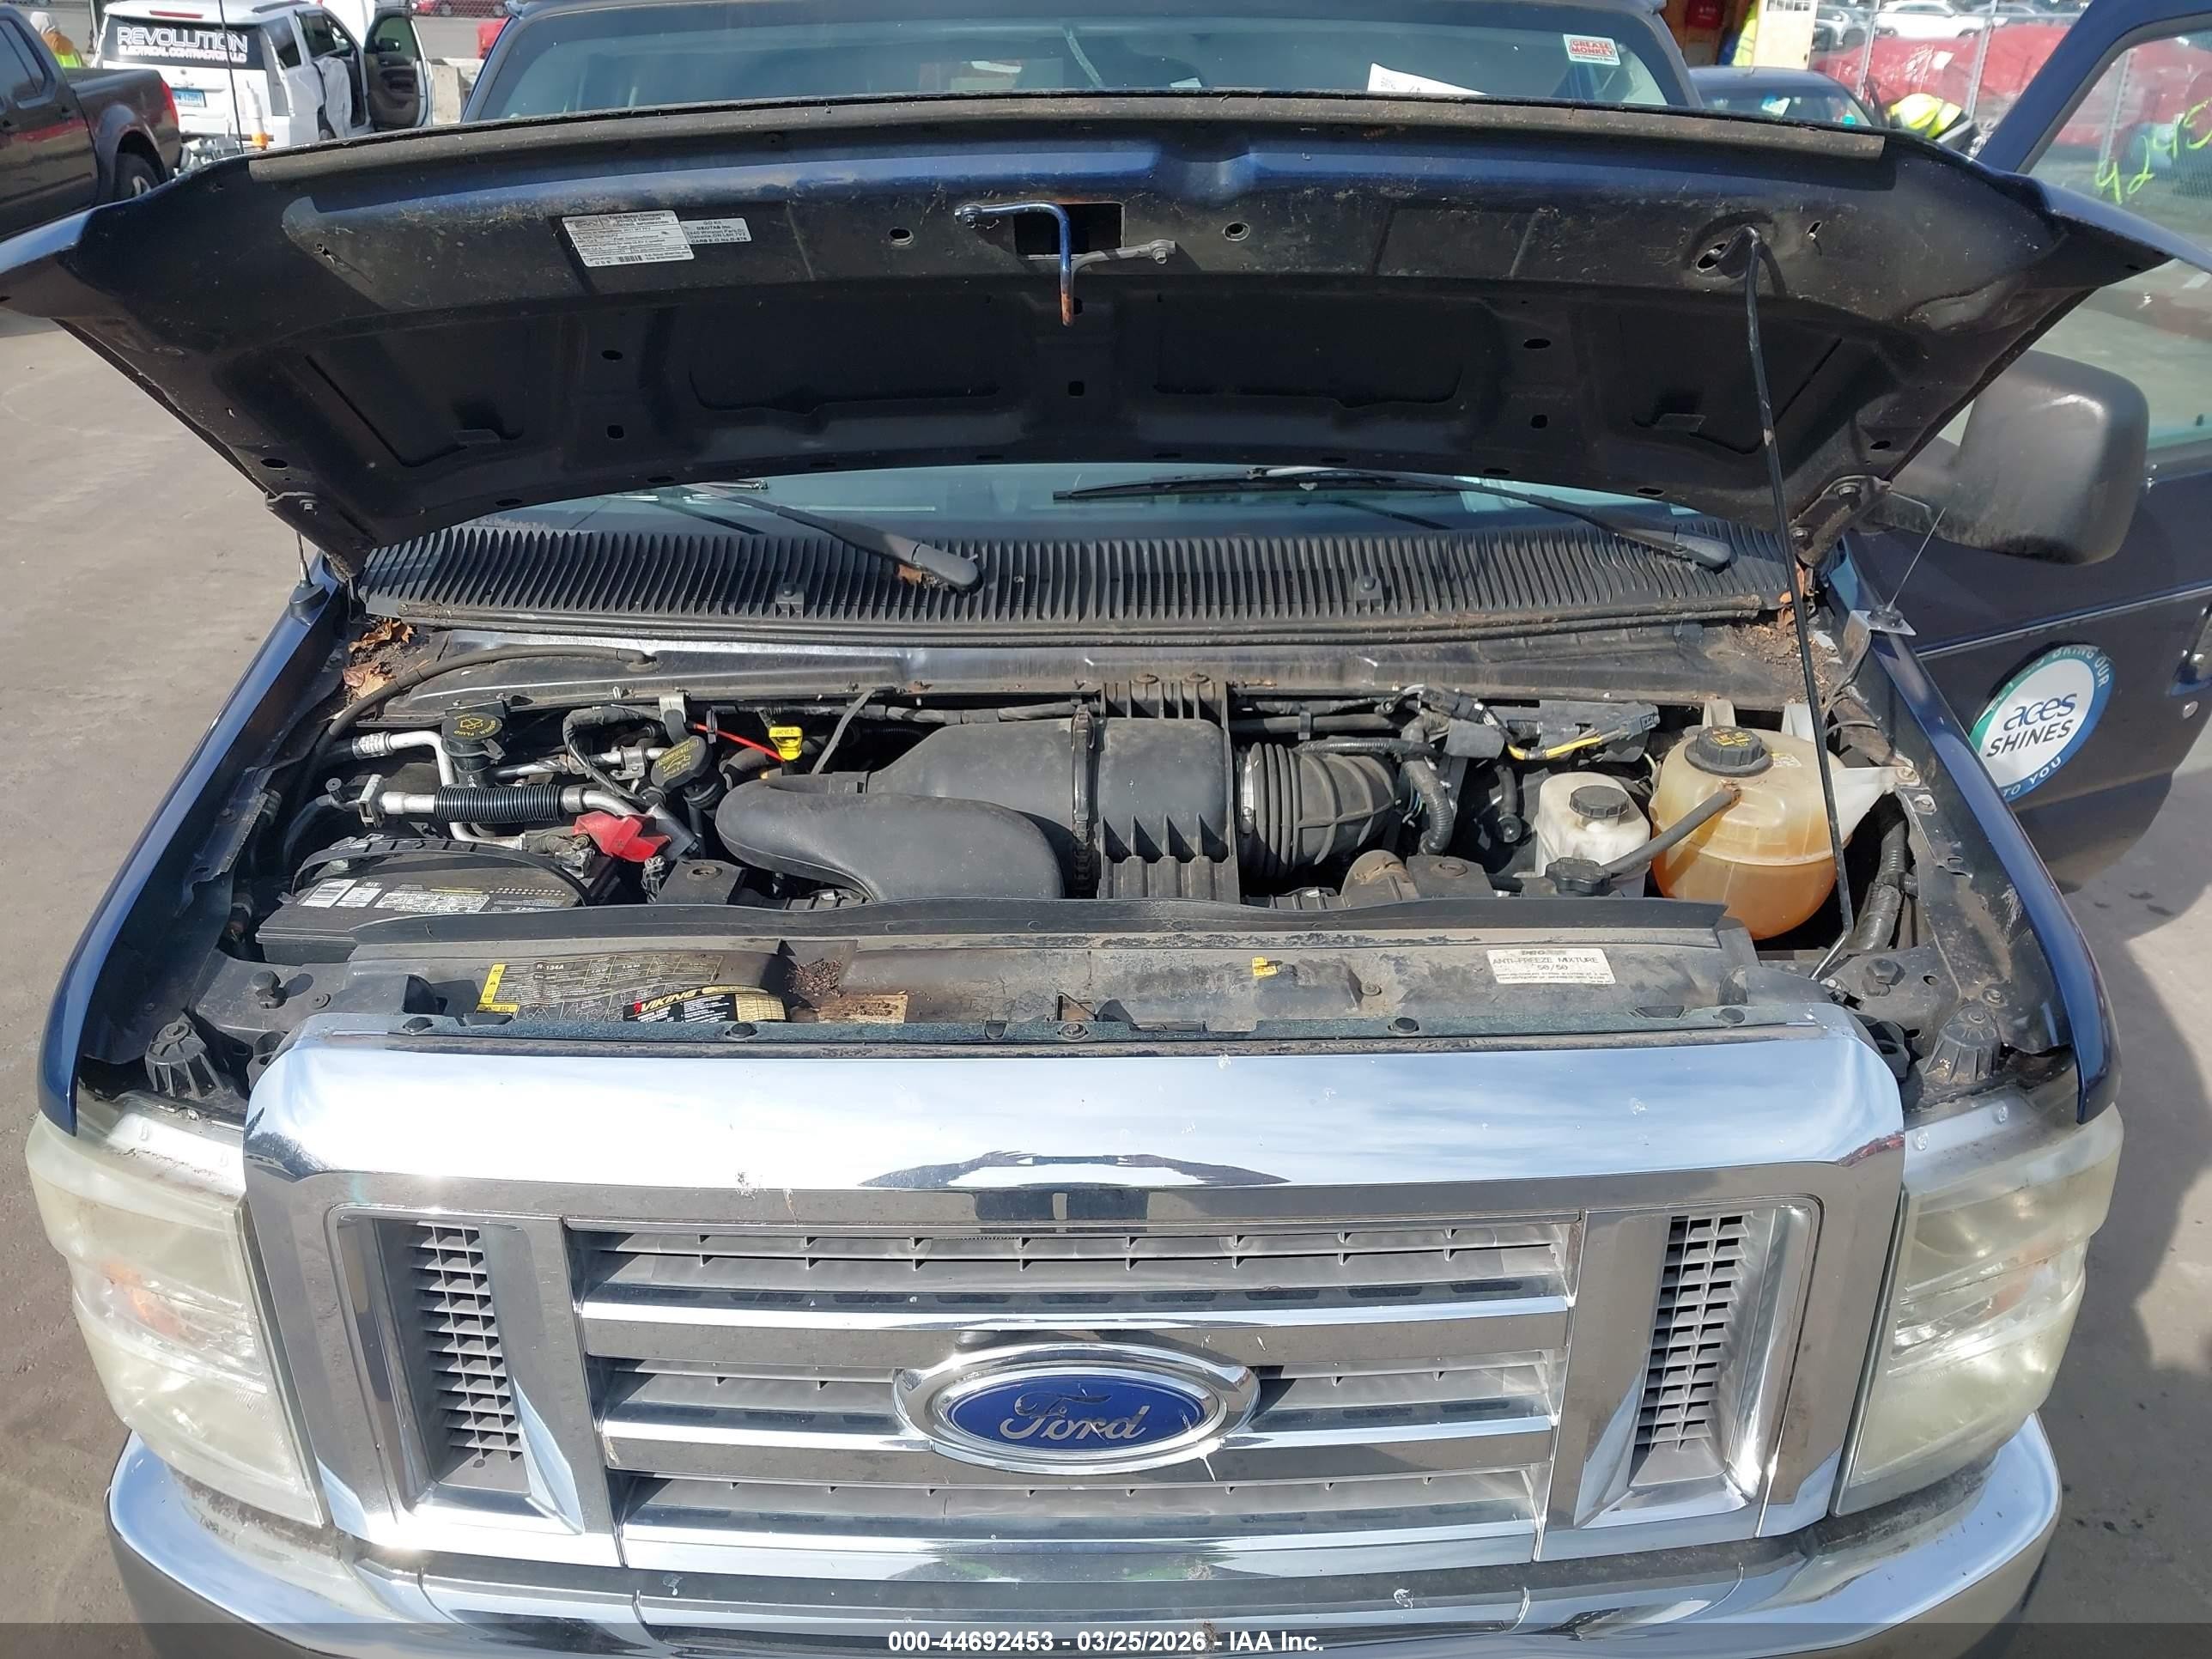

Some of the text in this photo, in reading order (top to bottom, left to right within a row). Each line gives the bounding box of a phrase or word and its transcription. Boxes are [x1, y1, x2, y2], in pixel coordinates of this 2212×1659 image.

[117, 27, 248, 53] REVOLUTION
[1571, 46, 1613, 56] MONKEY
[1572, 40, 1612, 49] GREASE
[2003, 693, 2078, 731] aces
[1985, 719, 2075, 757] SHINES
[2029, 756, 2062, 785] YOU
[641, 988, 699, 1012] VIKING
[999, 1391, 1151, 1441] Ford
